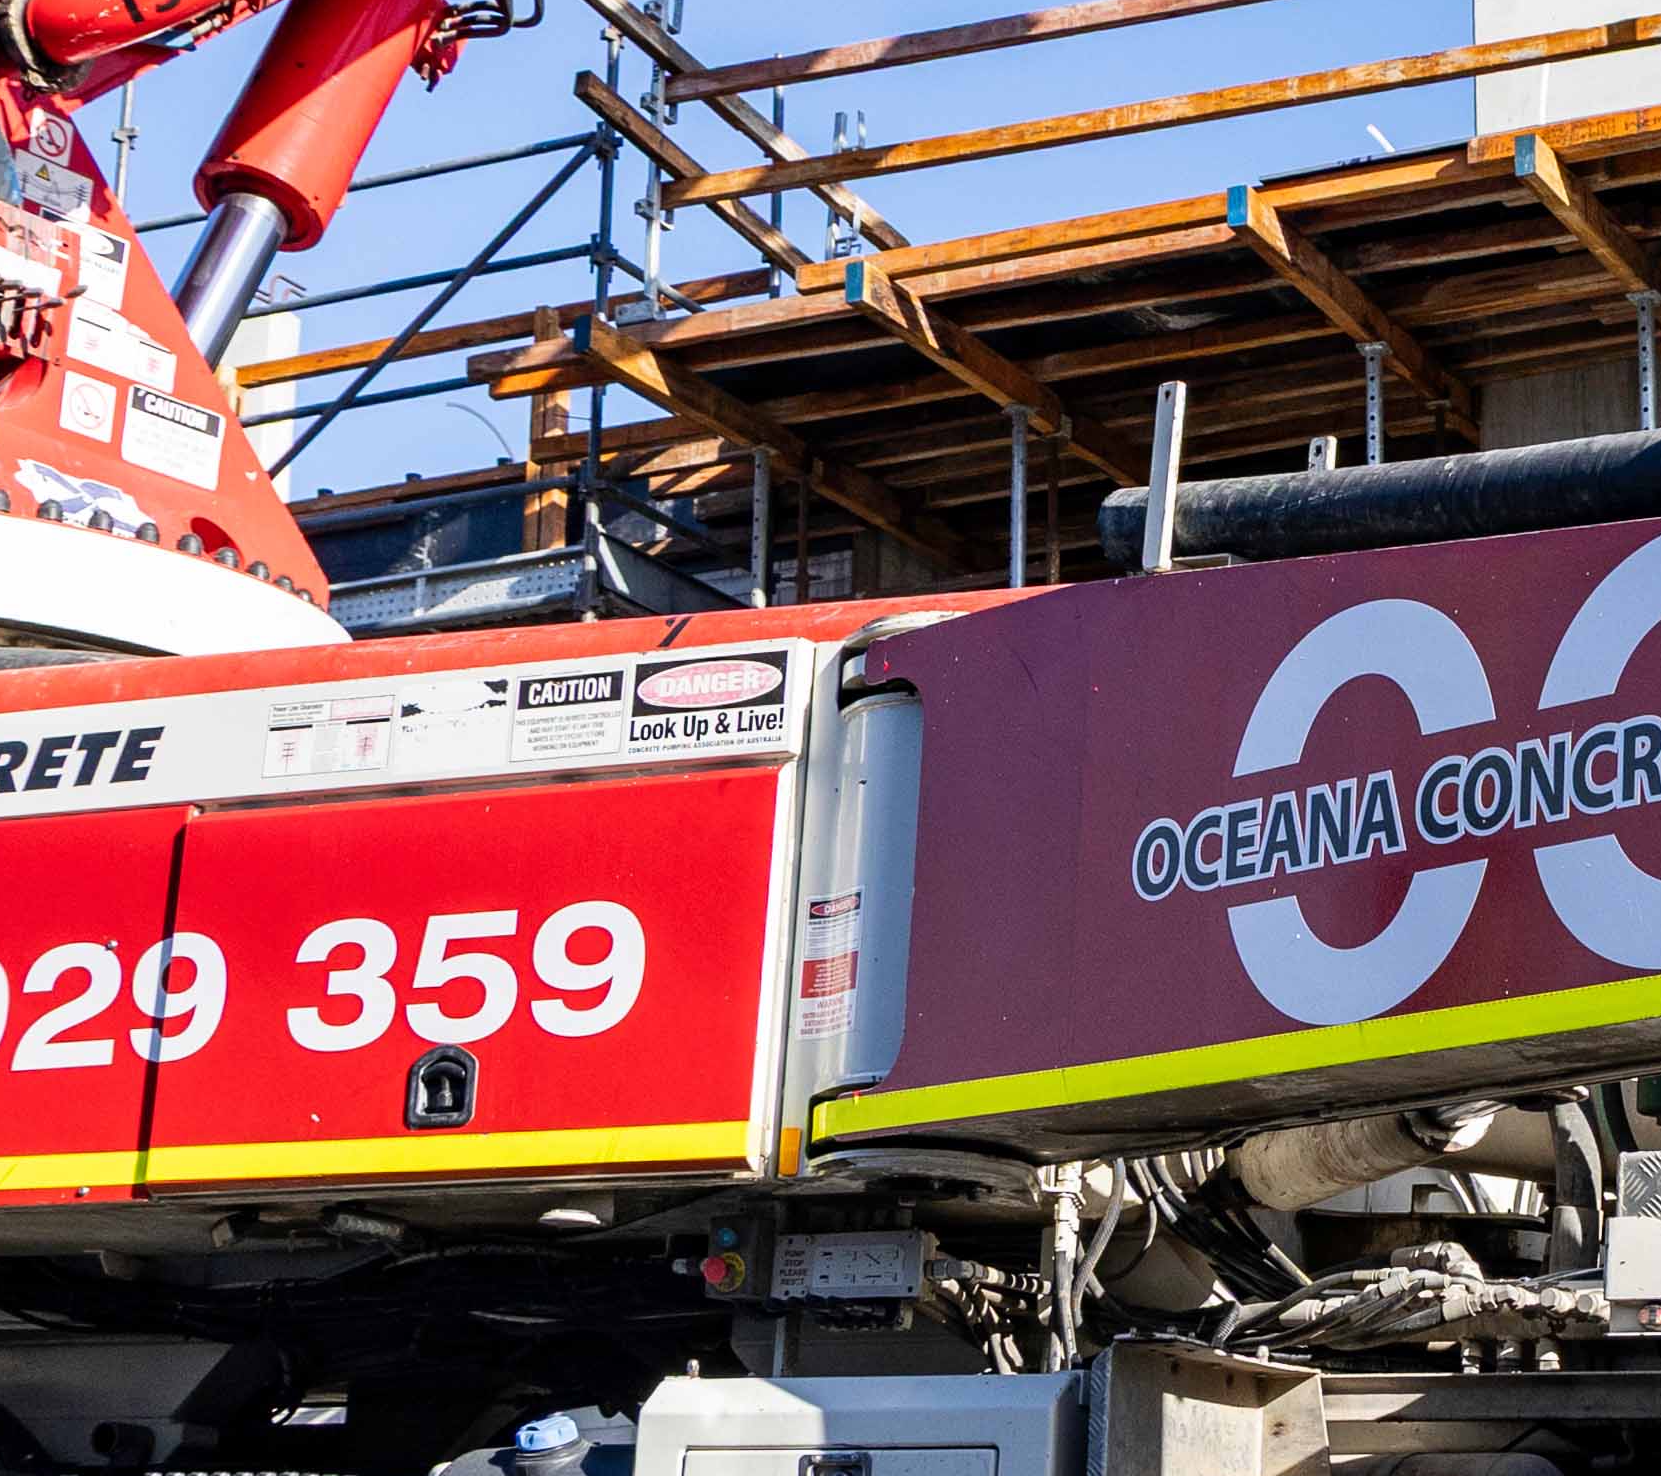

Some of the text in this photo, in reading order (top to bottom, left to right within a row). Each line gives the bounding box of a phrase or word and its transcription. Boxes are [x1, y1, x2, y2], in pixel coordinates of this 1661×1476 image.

[144, 393, 208, 432] CAUTION
[527, 676, 613, 706] CAUTION
[659, 671, 762, 698] DANGER
[629, 719, 676, 742] Look
[683, 717, 708, 740] Up
[715, 712, 730, 734] &
[737, 707, 785, 732] Live!
[1132, 768, 1405, 902] OCEANA
[286, 900, 648, 1054] 359
